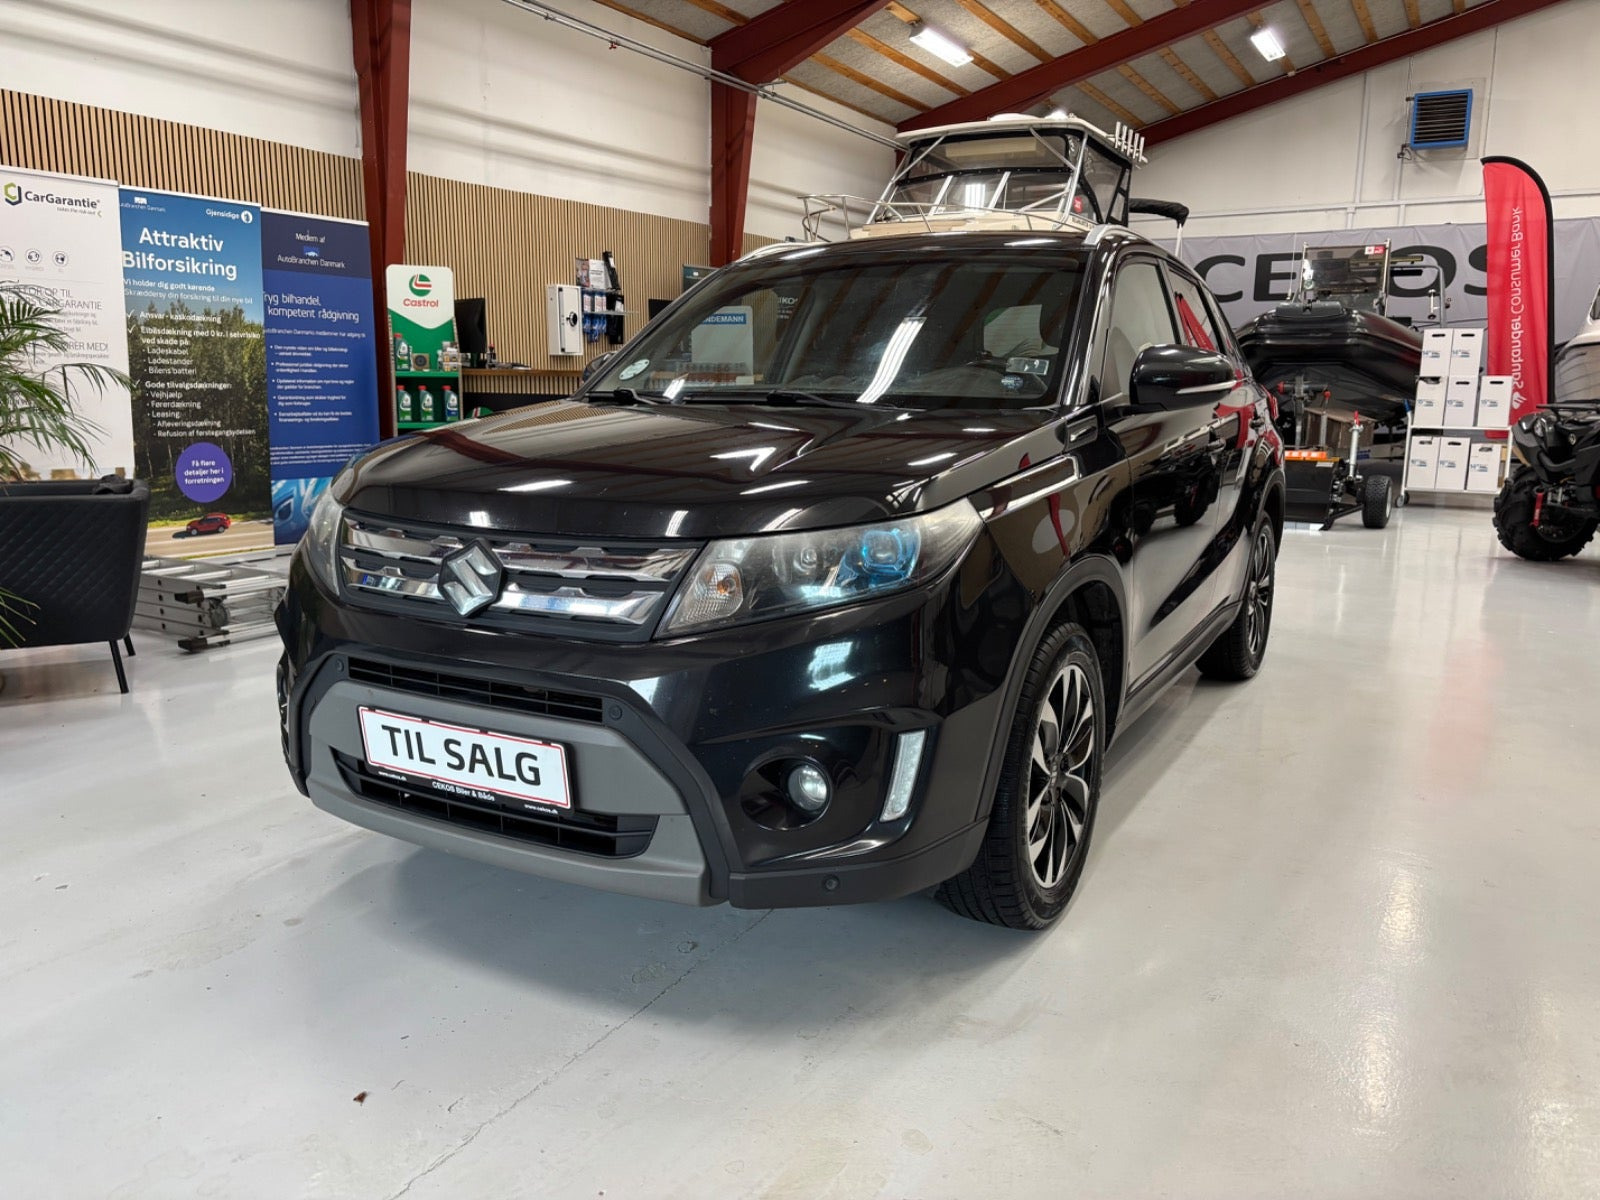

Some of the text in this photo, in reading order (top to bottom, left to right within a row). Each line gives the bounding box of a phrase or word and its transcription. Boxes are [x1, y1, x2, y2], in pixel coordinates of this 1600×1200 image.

[25, 191, 97, 209] CarGarantie
[205, 208, 239, 220] Gjensidige
[139, 227, 224, 252] Attraktiv
[295, 232, 318, 243] Medlem
[122, 250, 238, 281] Bilforsikring
[277, 255, 345, 269] AutoBranchen Danmark
[1194, 244, 1488, 304] CEO
[157, 281, 168, 290] dig
[169, 282, 187, 291] godt
[187, 284, 215, 292] kørende
[168, 291, 179, 299] din
[179, 292, 212, 303] forsikring
[220, 294, 231, 302] din
[281, 292, 321, 306] bilhandel,
[403, 298, 439, 308] Castrol
[170, 312, 222, 324] kaskodækning
[268, 306, 360, 324] kompetent rådgivning
[193, 329, 209, 337] med
[141, 337, 155, 345] ved
[145, 380, 165, 389] Gode
[152, 410, 180, 419] Leasing
[381, 724, 541, 786] TIL SALG
[431, 781, 455, 793] CEKOS
